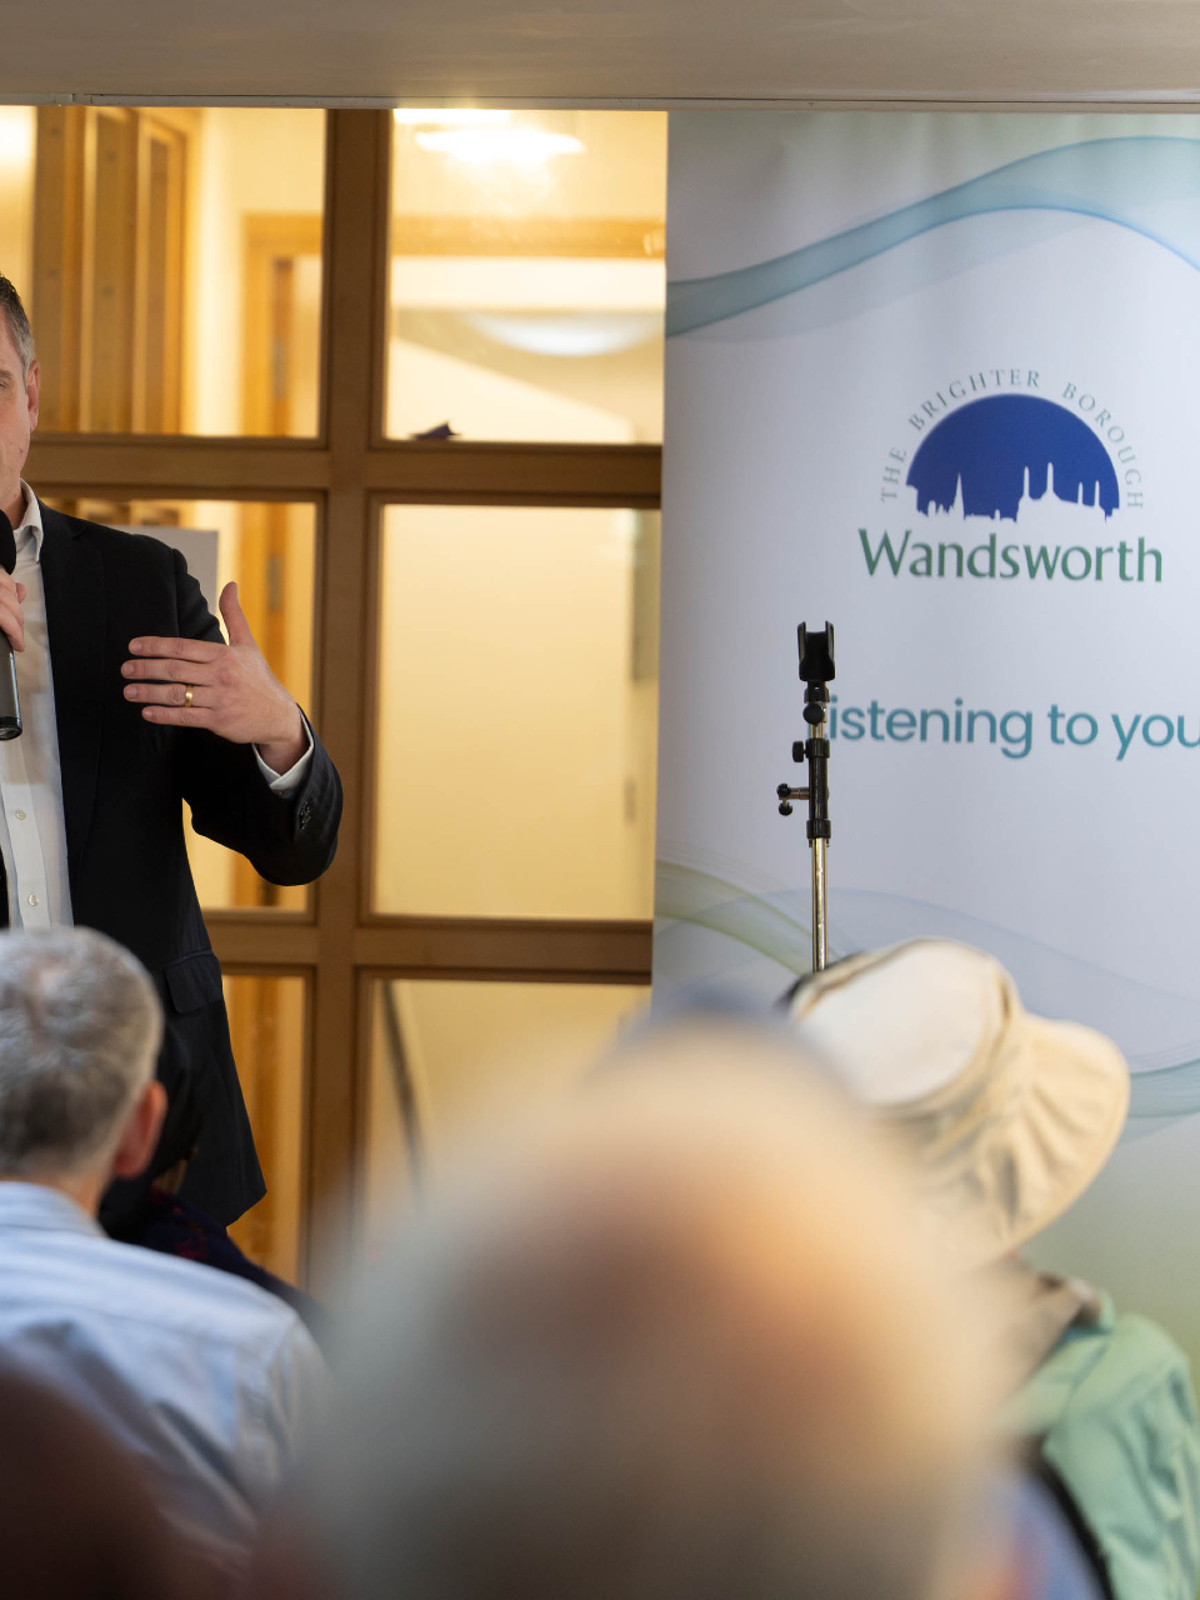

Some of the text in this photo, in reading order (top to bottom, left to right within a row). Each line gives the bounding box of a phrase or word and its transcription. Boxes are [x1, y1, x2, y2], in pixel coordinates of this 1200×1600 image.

[880, 368, 1145, 509] THE BRIGHTER BOROUGH
[857, 527, 1163, 583] Wandsworth
[806, 695, 1034, 760] istening
[1046, 703, 1099, 746] to
